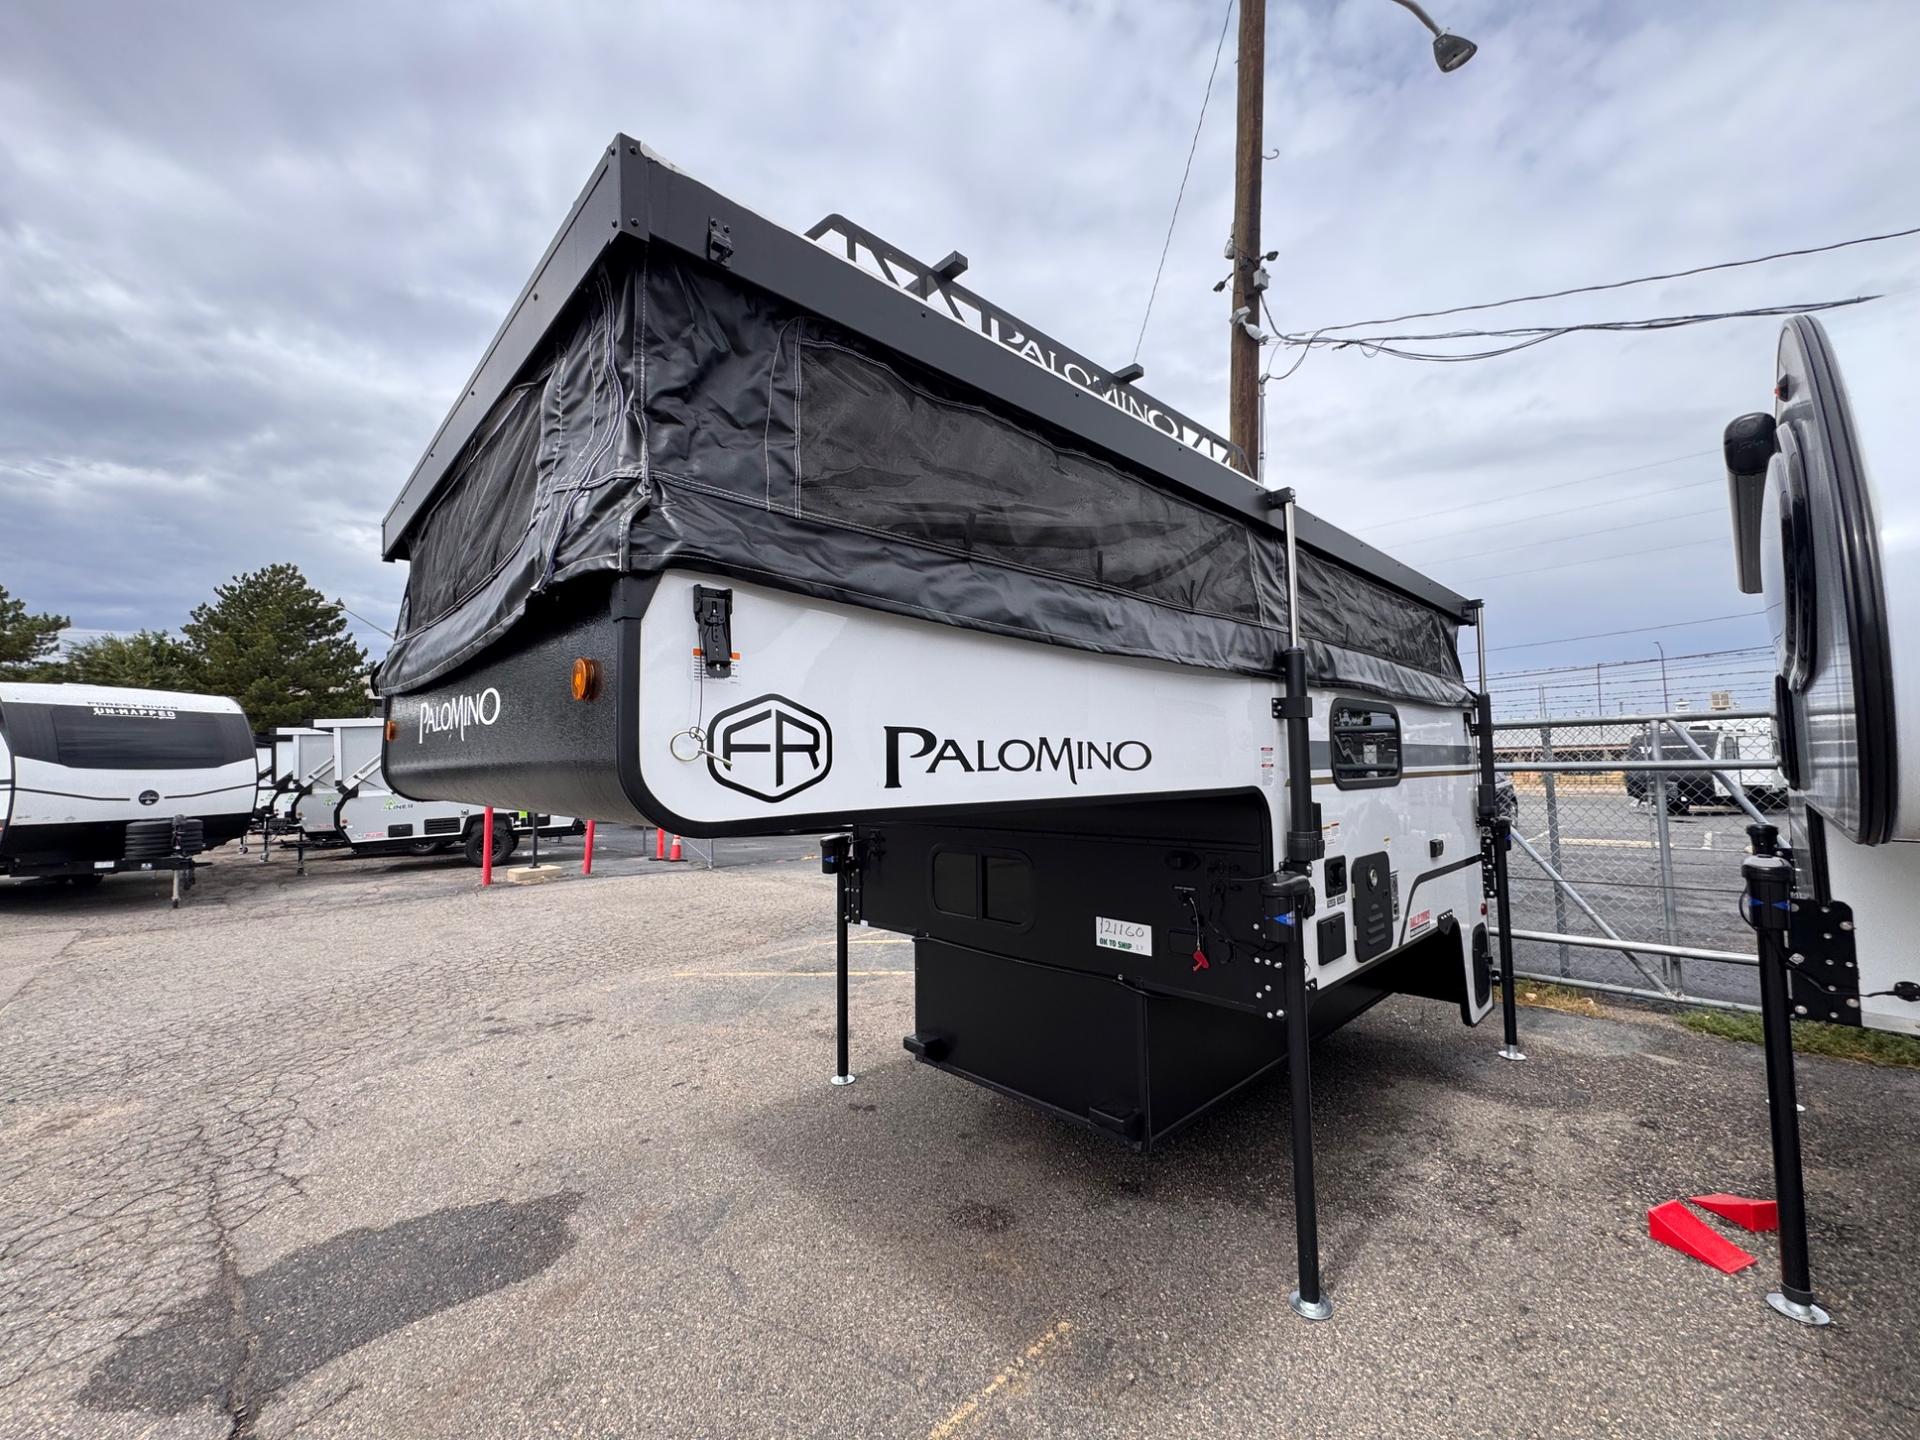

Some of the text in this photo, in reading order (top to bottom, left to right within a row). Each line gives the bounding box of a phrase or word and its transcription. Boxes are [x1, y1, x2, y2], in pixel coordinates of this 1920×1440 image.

[418, 687, 500, 744] PALOMINO
[722, 708, 820, 788] FR
[884, 725, 1152, 789] PALOMINO
[1099, 937, 1108, 946] OK
[1109, 939, 1117, 947] TO
[1117, 941, 1133, 950] SHIP
